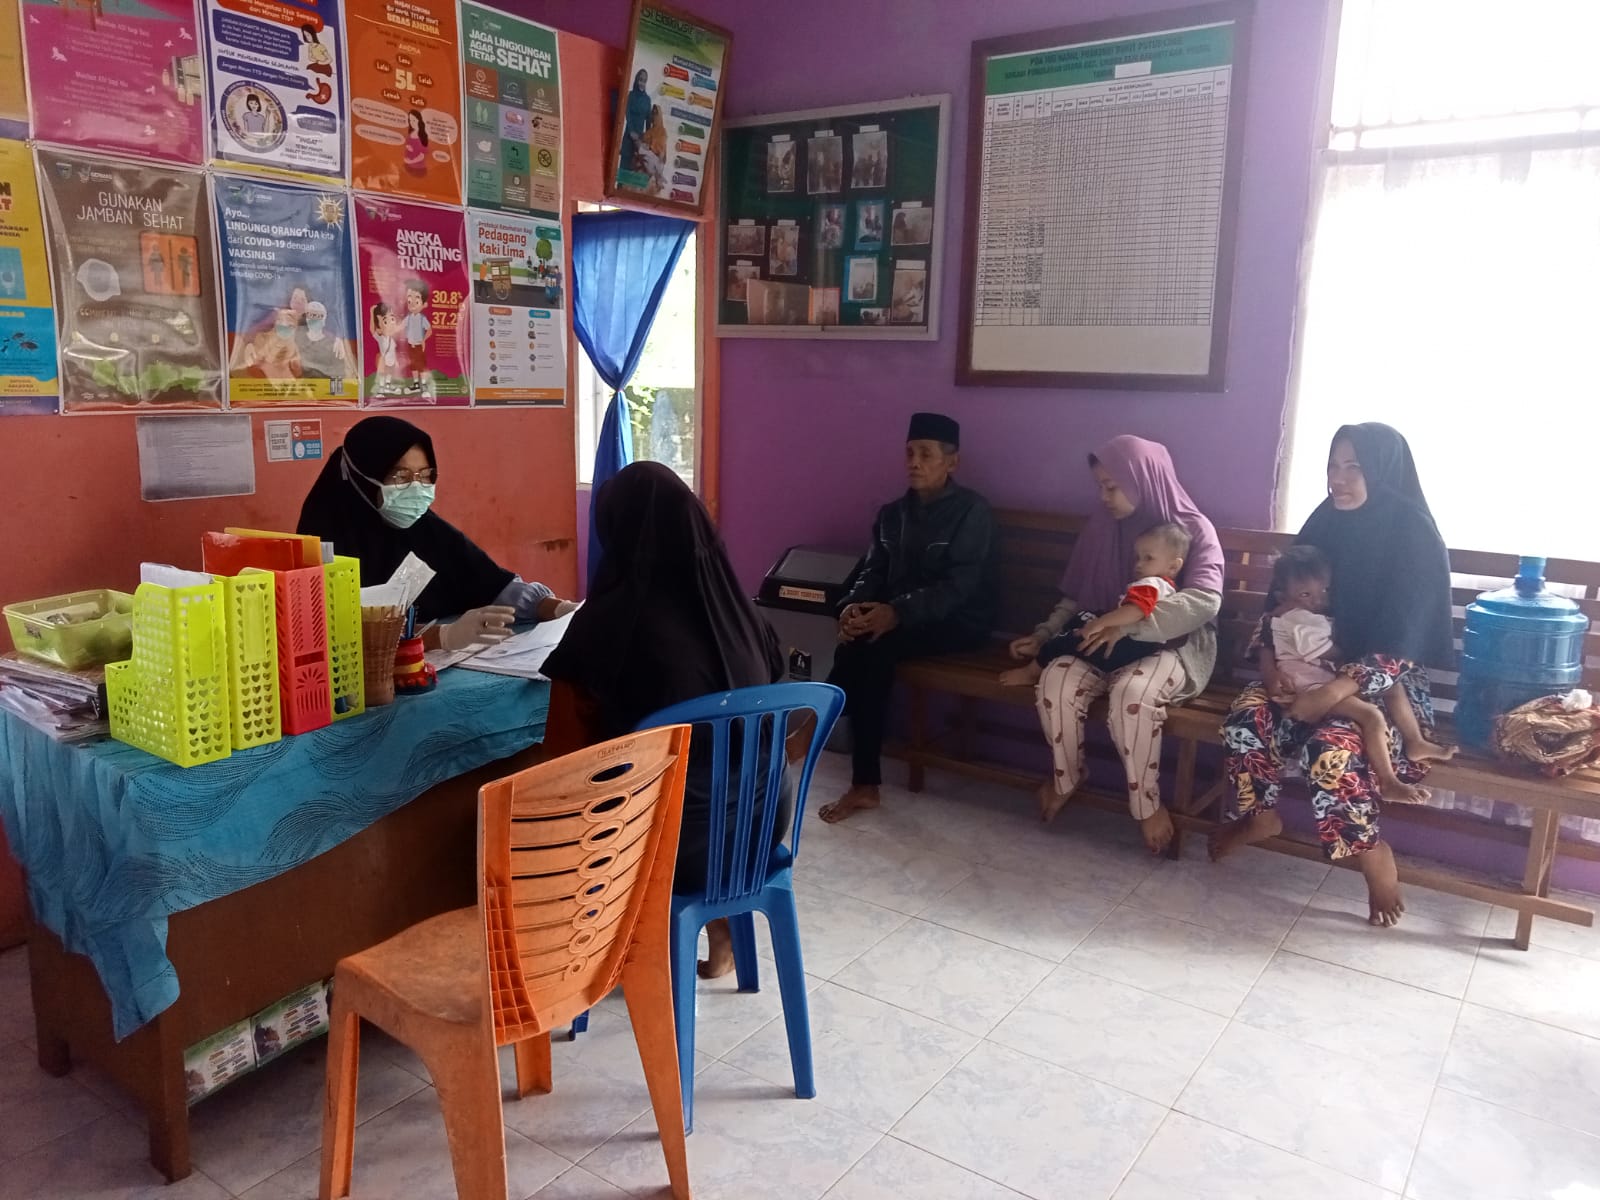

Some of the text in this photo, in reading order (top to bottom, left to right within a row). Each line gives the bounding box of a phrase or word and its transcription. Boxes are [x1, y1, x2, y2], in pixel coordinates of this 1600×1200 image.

[469, 29, 551, 62] JAGA LINGKUNGAN
[470, 39, 494, 54] AGAR
[469, 48, 551, 79] TETAP SEHAT
[395, 69, 416, 91] 5L
[98, 191, 162, 213] GUNAKAN
[76, 205, 184, 230] JAMBAN SEHAT
[225, 220, 270, 234] LINDUNGI
[271, 226, 302, 237] ORANG
[302, 228, 320, 239] TUA
[396, 229, 442, 247] ANGKA
[478, 227, 527, 246] Pedagang
[227, 235, 315, 253] dari COVID-19 dengan
[396, 242, 463, 262] STUNTING
[479, 243, 525, 258] Kaki Lima
[228, 248, 275, 260] VAKSINASI
[397, 255, 444, 273] TURUN
